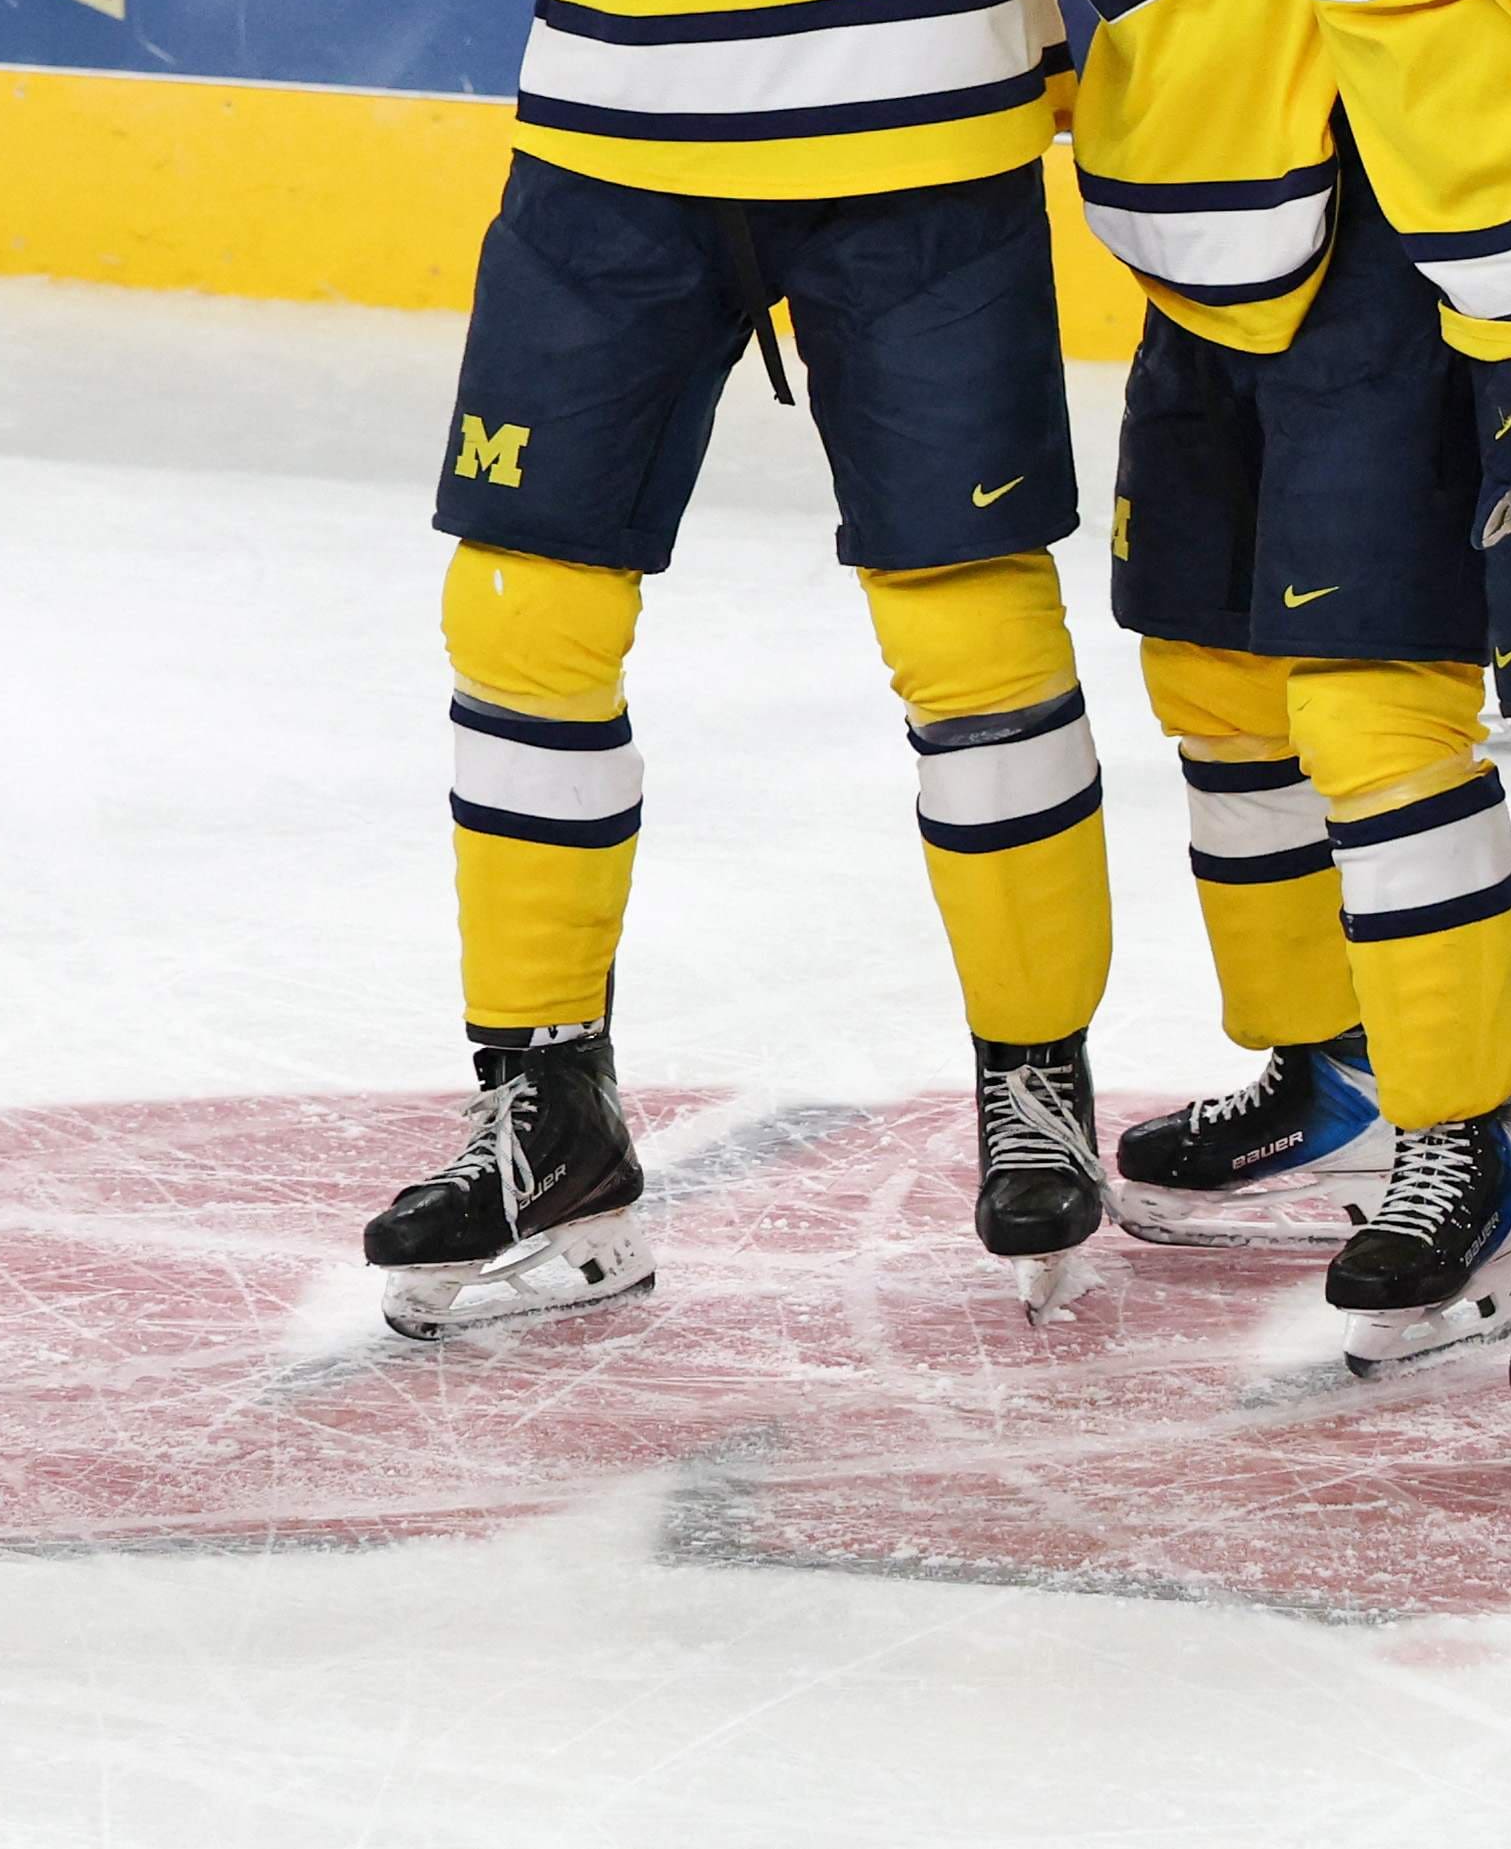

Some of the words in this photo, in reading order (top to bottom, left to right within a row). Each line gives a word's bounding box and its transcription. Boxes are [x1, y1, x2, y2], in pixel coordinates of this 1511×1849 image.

[454, 413, 531, 488] M
[1232, 1129, 1305, 1171] BAUER
[518, 1163, 567, 1211] AUER
[1464, 1211, 1501, 1270] BAUER
